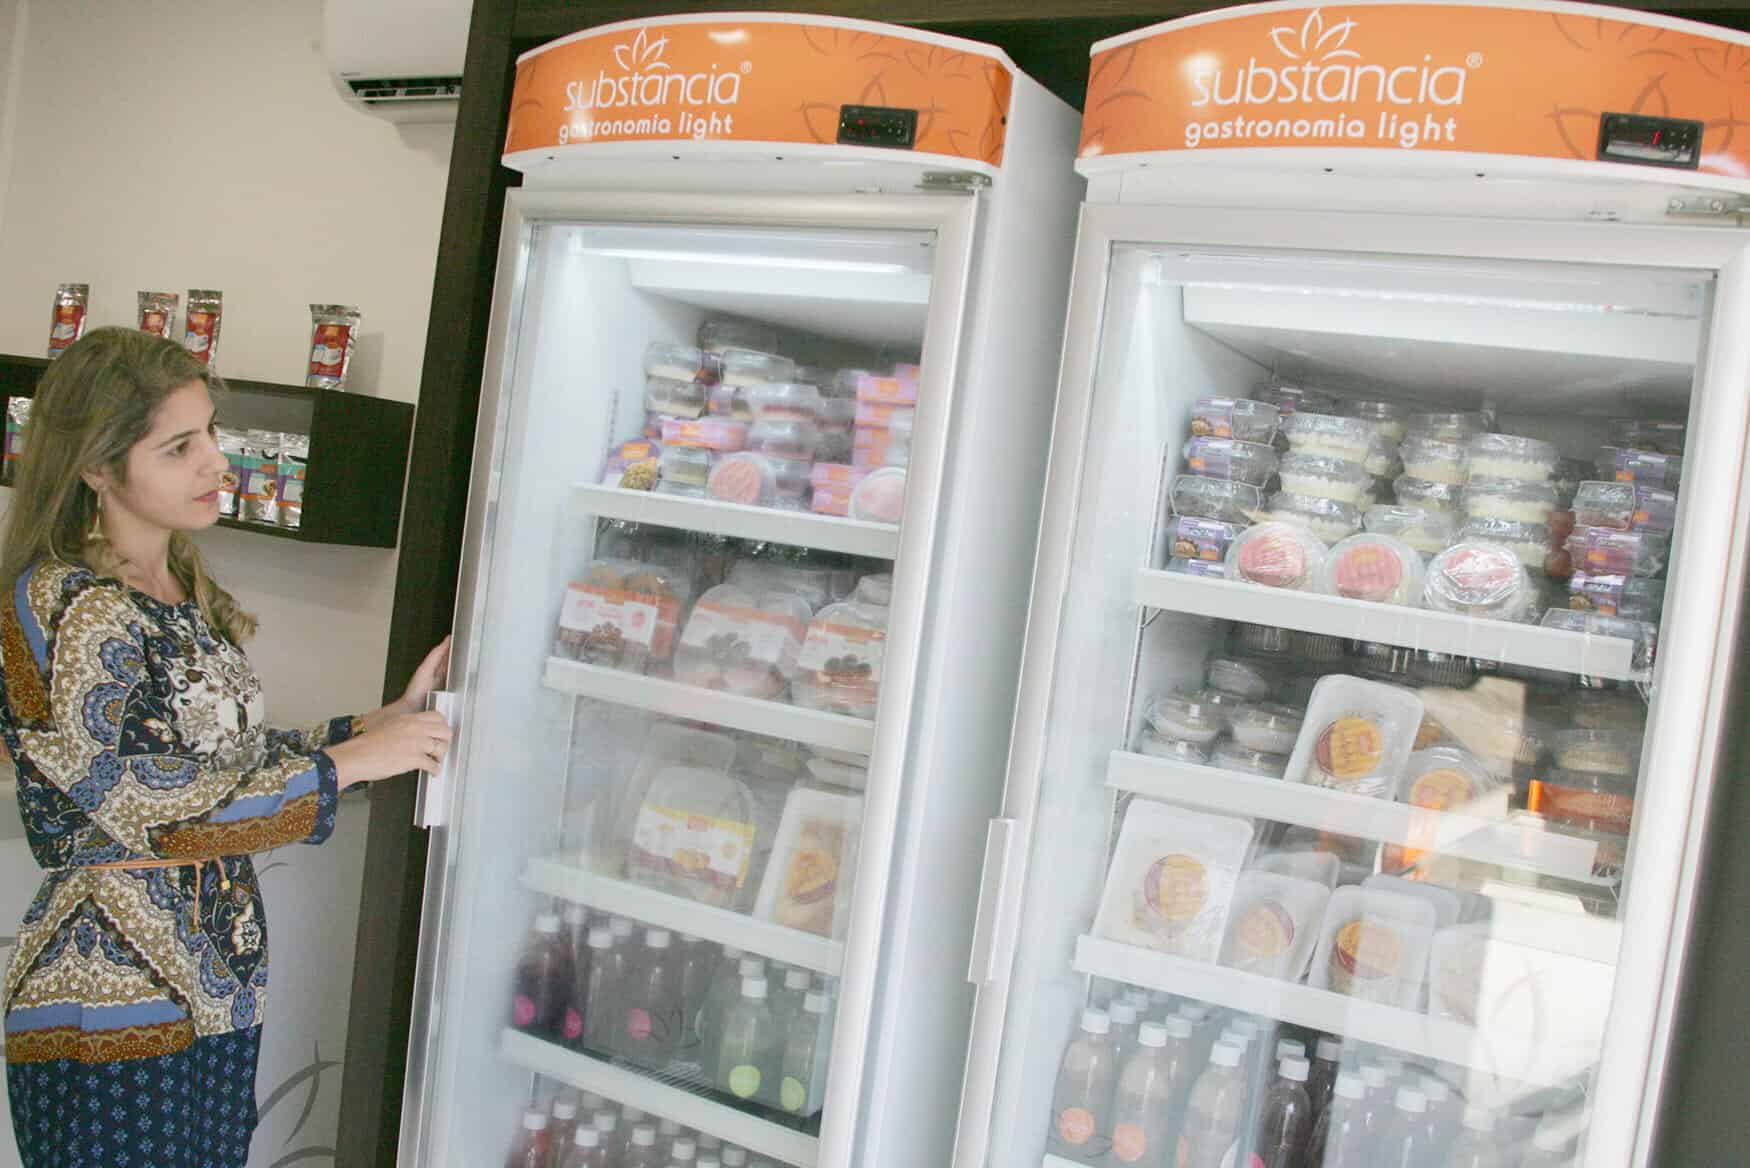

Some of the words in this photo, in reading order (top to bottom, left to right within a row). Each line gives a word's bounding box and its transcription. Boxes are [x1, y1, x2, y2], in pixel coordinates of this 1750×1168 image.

[678, 112, 734, 141] light
[1185, 113, 1365, 148] gastronomia
[1377, 112, 1457, 148] light
